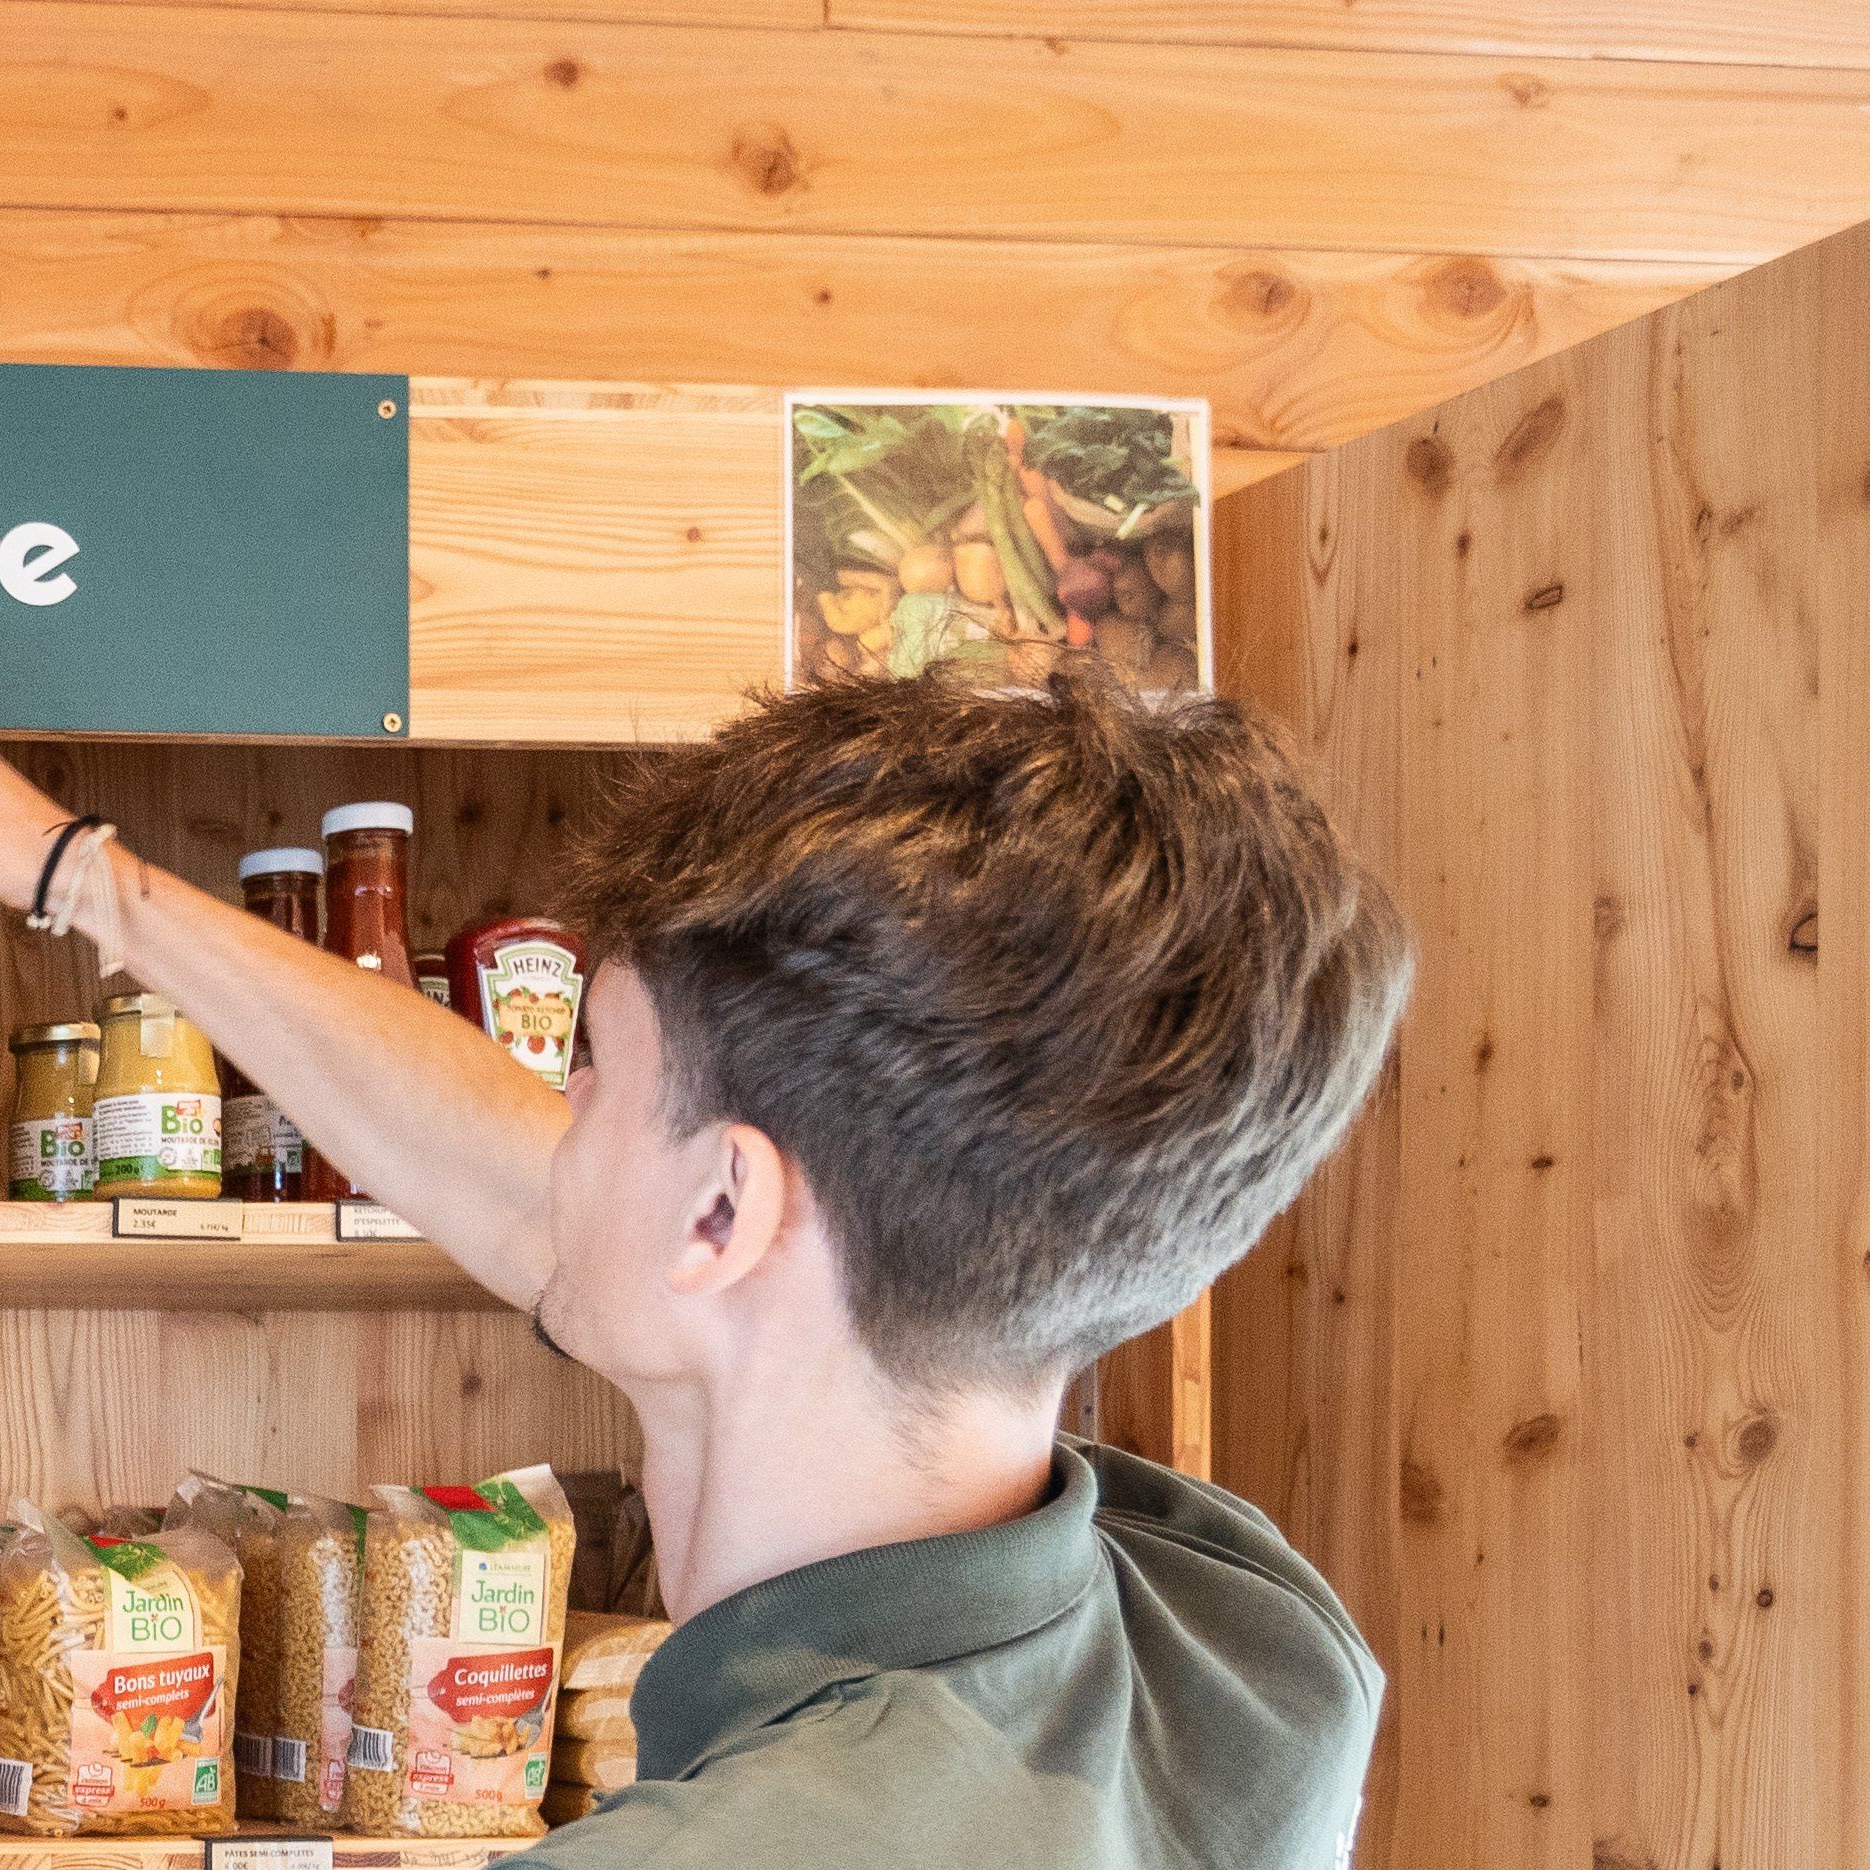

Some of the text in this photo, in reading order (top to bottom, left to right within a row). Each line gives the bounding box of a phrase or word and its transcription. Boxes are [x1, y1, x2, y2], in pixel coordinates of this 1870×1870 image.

[513, 955, 562, 977] HEINZ
[521, 1013, 553, 1032] BIO
[132, 1207, 178, 1217] MOUTARDE
[121, 1589, 185, 1615] Jardin
[113, 1661, 211, 1694] Bons tuyaux
[454, 1660, 548, 1688] Coquillettes
